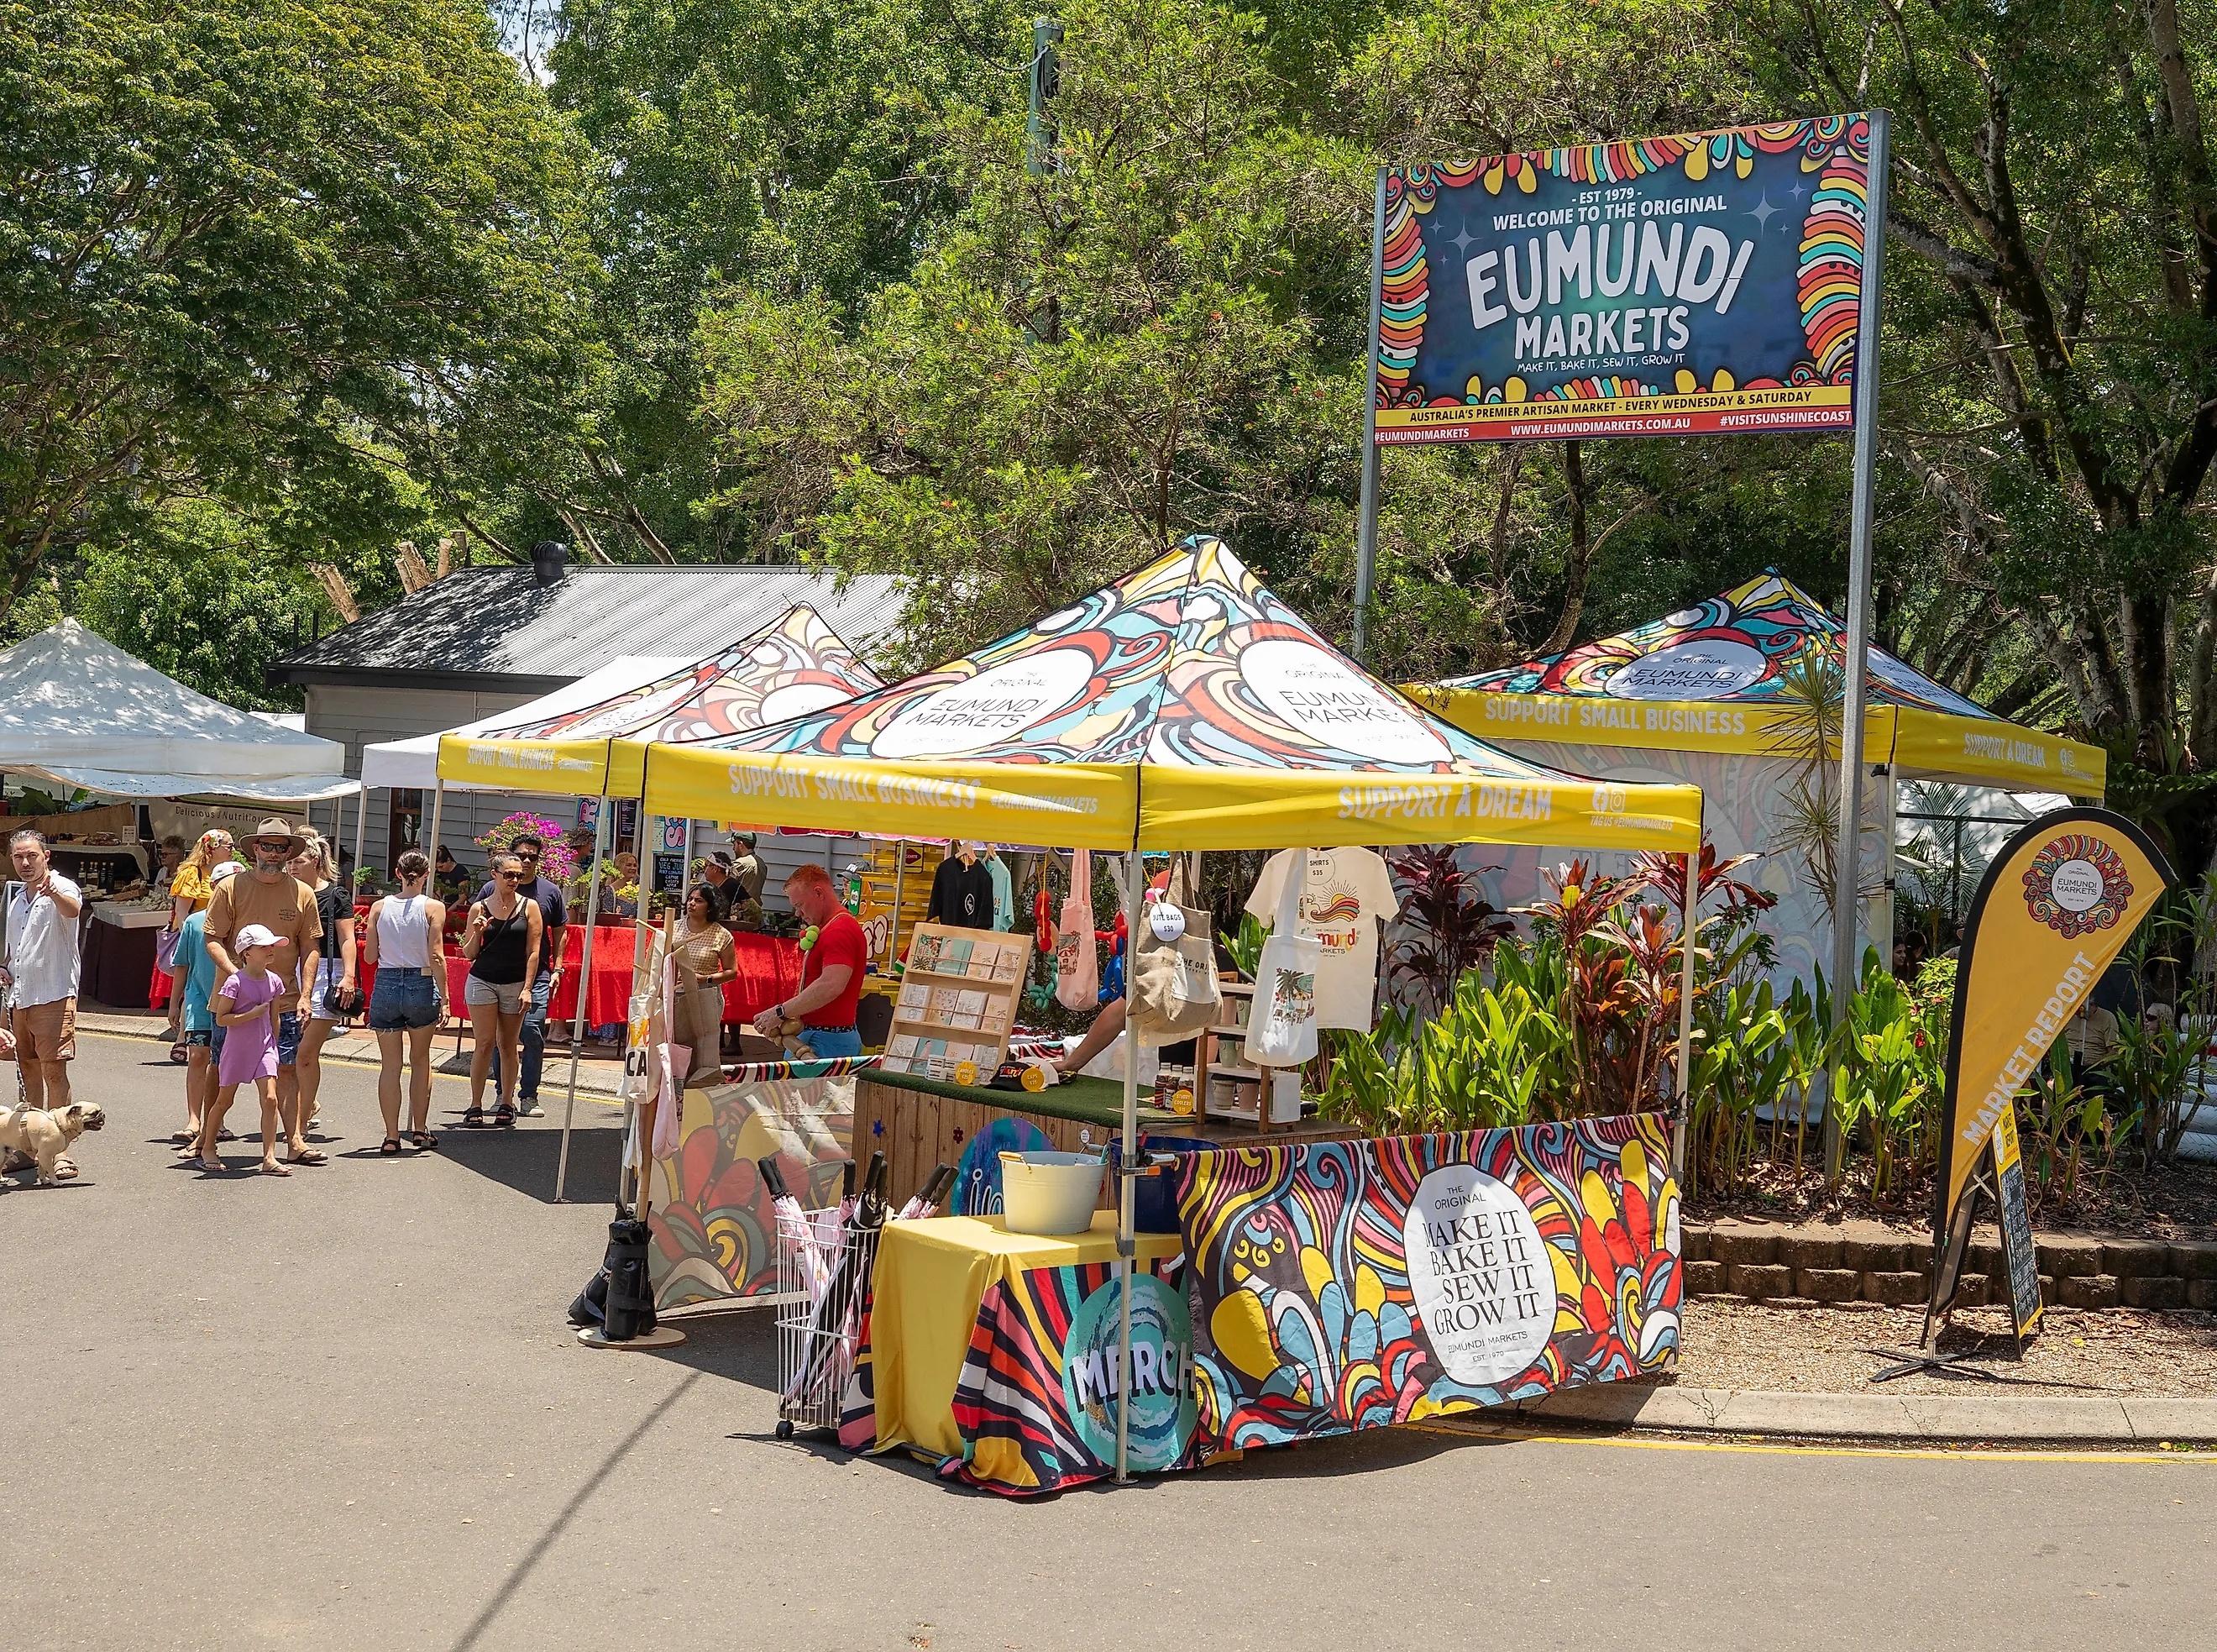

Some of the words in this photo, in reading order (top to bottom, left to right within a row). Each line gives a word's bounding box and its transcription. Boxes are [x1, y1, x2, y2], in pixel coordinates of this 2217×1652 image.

[1579, 190, 1601, 204] EST
[1604, 186, 1635, 202] 1979
[1492, 207, 1574, 231] WELCOME
[1578, 205, 1601, 223] TO
[1604, 202, 1637, 220] THE
[1640, 195, 1727, 217] ORIGINAL
[1465, 219, 1755, 331] EUMUNDI
[1514, 305, 1690, 359] MARKETS
[1517, 362, 1544, 373] MAKE
[1546, 360, 1558, 372] IT,
[1560, 359, 1585, 370] BAKE
[1588, 358, 1600, 370] IT,
[1601, 357, 1624, 368] SEW
[1626, 355, 1638, 367] IT,
[1642, 354, 1673, 365] GROW
[1675, 353, 1685, 364] IT
[1410, 409, 1474, 422] AUSTRALIA'S
[1475, 406, 1520, 418] PREMIER
[1523, 404, 1569, 416] ARTISAN
[1571, 401, 1617, 413] MARKET
[1625, 400, 1659, 412] EVERY
[1662, 396, 1734, 410] WEDNESDAY
[1737, 394, 1746, 405] &
[1749, 391, 1812, 405] SATURDAY
[1374, 427, 1470, 442] #EUMUNDIMARKETS
[1511, 417, 1690, 436] WWW.EUMUNDIMARKETS.COM.AU
[1719, 410, 1852, 427] #VISITSUNSHINECOAST
[1622, 677, 1735, 689] MARKETS
[1634, 669, 1743, 680] EUMUNDI
[930, 699, 1049, 713] EUMUNDI
[1485, 698, 1571, 725] SUPPORT
[1580, 705, 1641, 730] SMALL
[1645, 707, 1746, 736] BUSINESS
[906, 712, 1026, 728] MARKETS
[467, 743, 499, 766] SUPPORT
[498, 746, 520, 768] SMALL
[519, 747, 556, 770] BUSINESS
[1964, 732, 2005, 760] SUPPORT
[2007, 739, 2014, 761] A
[2015, 741, 2047, 768] DREAM
[728, 763, 810, 799] SUPPORT
[814, 771, 872, 803] SMALL
[877, 774, 982, 810] BUSINESS
[176, 805, 215, 819] Delicious
[222, 811, 265, 824] Nutritiou
[1338, 785, 1452, 819] SUPPORT
[1454, 784, 1471, 817] A
[1476, 784, 1552, 821] DREAM
[1591, 816, 1603, 826] TAG
[1604, 816, 1613, 826] US
[658, 862, 671, 870] VEG
[2057, 878, 2097, 889] EUMUNDI
[2057, 885, 2098, 896] MARKETS
[1962, 1045, 2035, 1146] MARKET
[2025, 951, 2096, 1049] REPORT
[1434, 1192, 1486, 1210] ORIGINAL
[1446, 1185, 1465, 1195] THE
[1422, 1213, 1492, 1247] MAKE
[1495, 1209, 1522, 1237] IT
[1430, 1240, 1498, 1277] BAKE
[1501, 1236, 1528, 1264] IT
[1442, 1269, 1499, 1304] SEW
[1510, 1264, 1536, 1292] IT
[1434, 1297, 1507, 1335] GROW
[1513, 1292, 1541, 1320] IT
[1448, 1339, 1486, 1354] EUMUNDI
[1487, 1330, 1528, 1345] MARKETS
[1472, 1354, 1486, 1362] EST
[1071, 1340, 1196, 1405] MERCH
